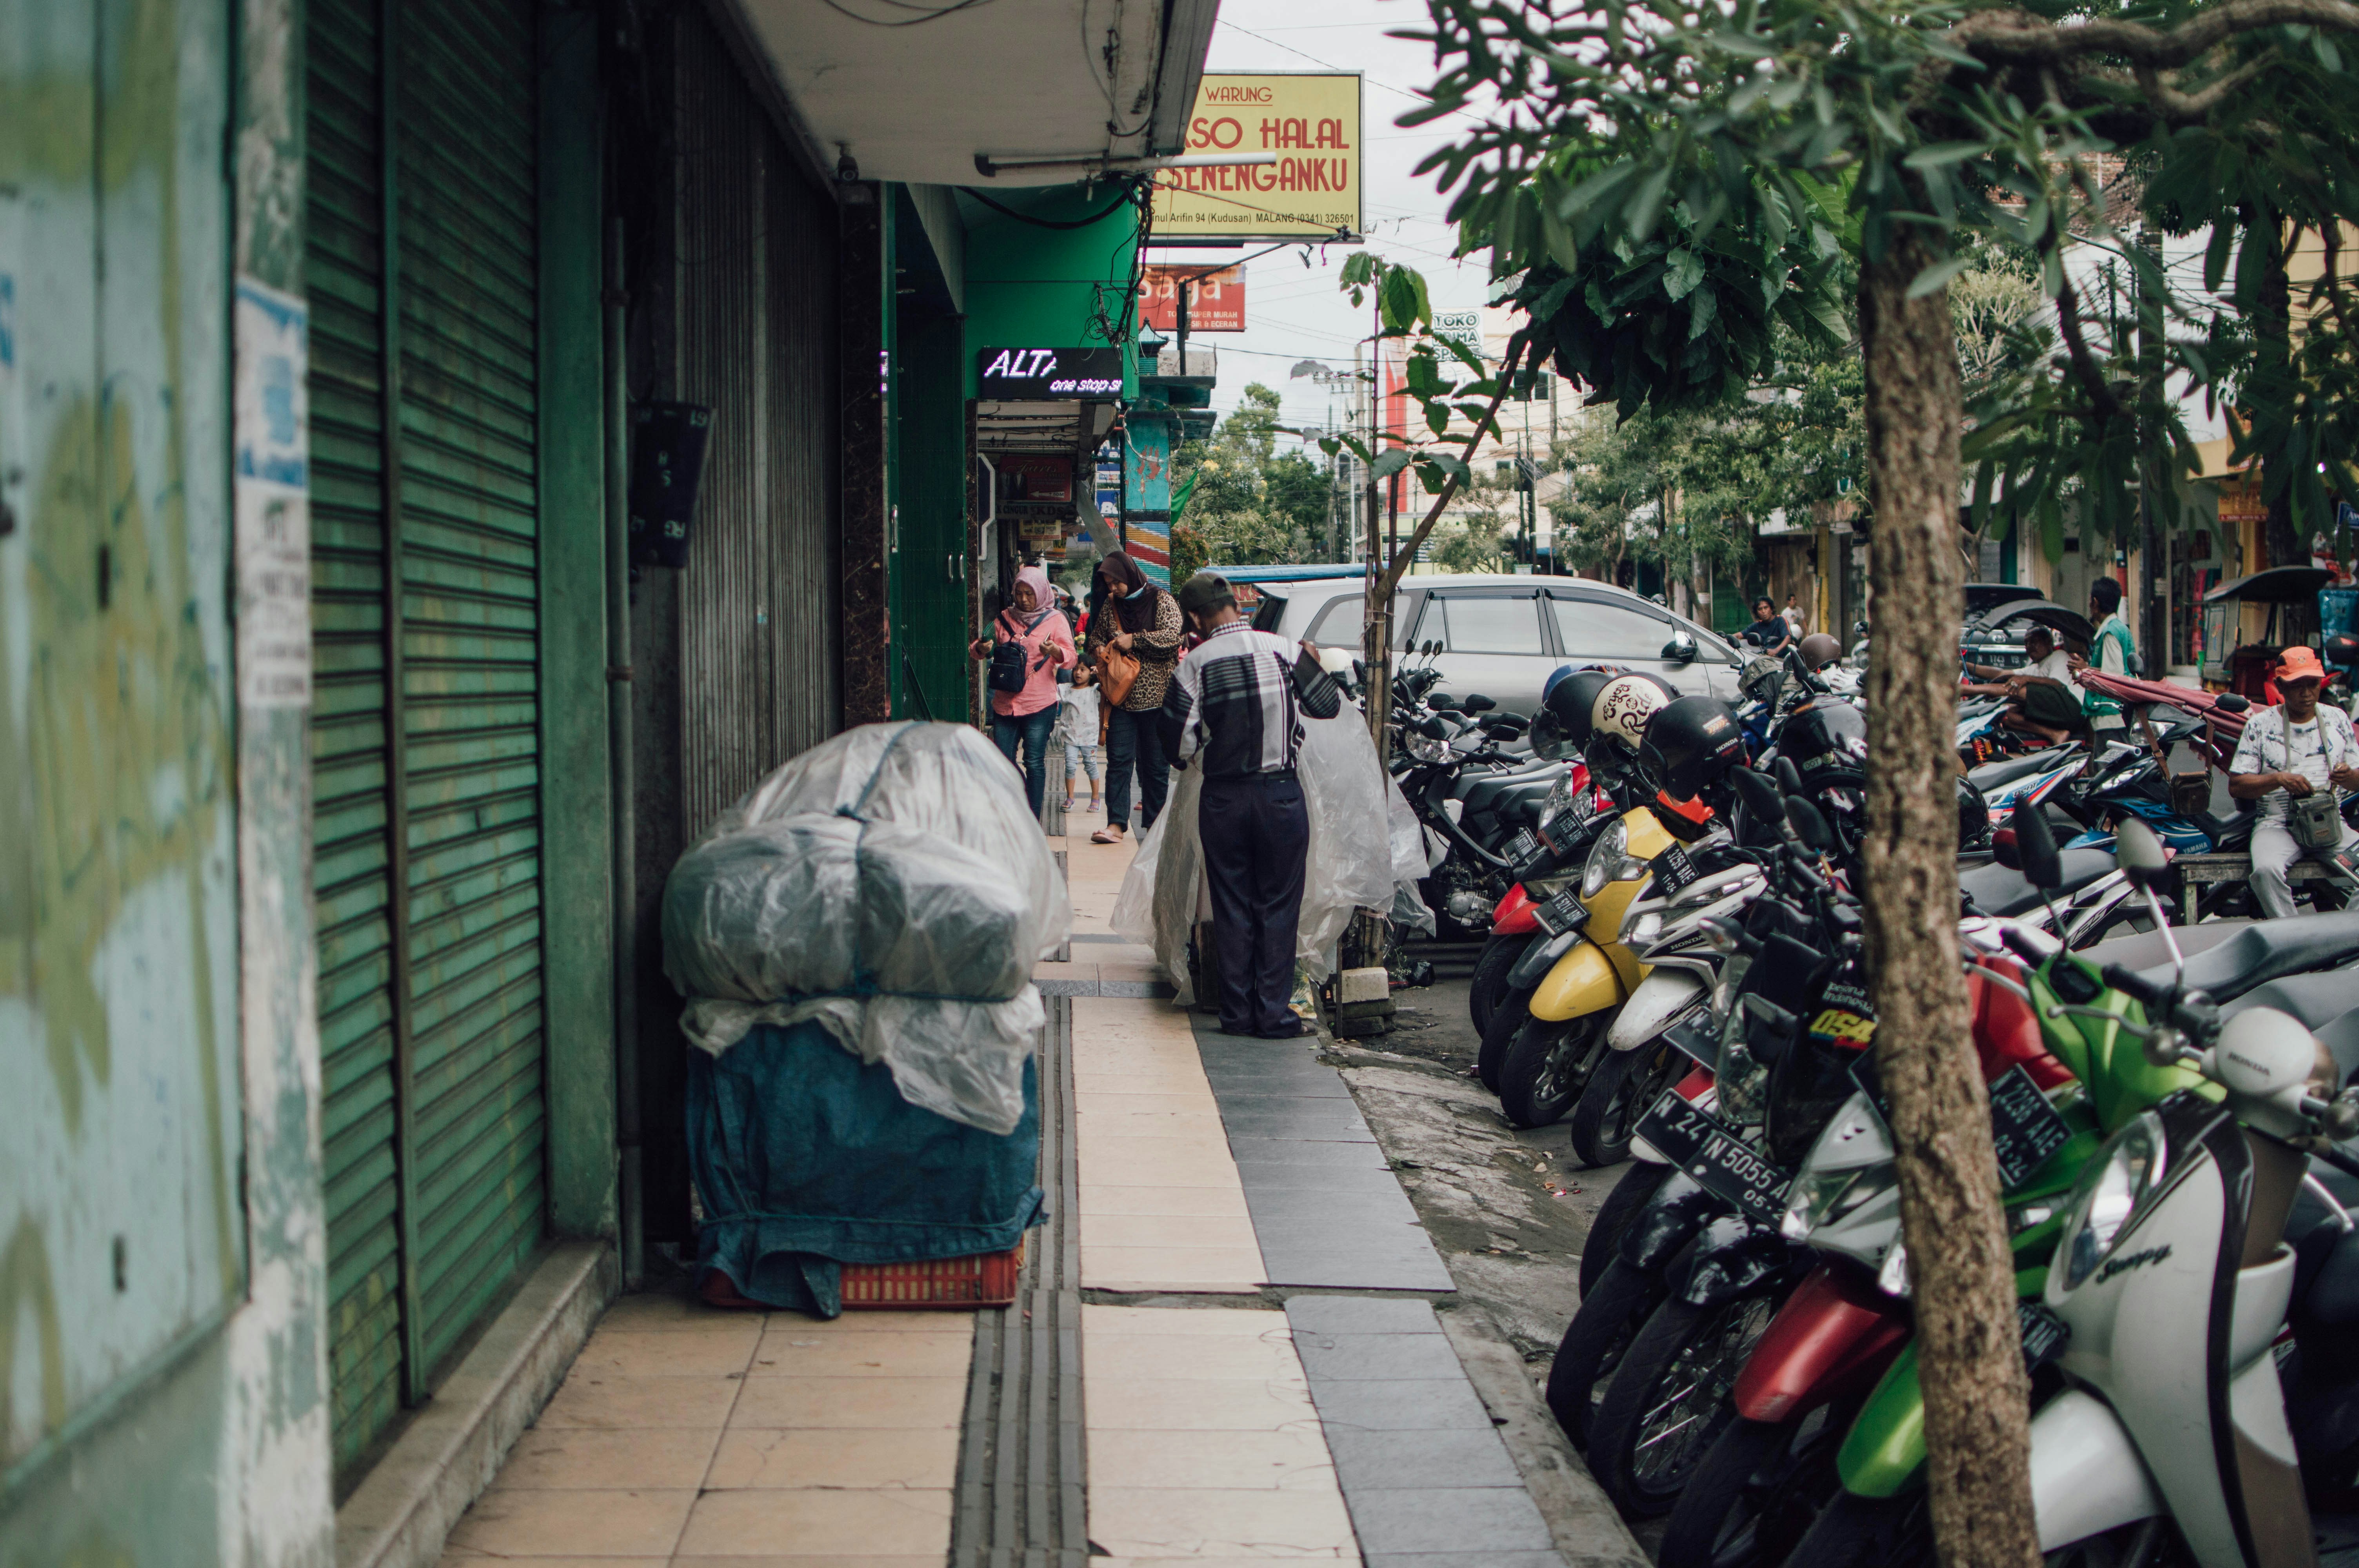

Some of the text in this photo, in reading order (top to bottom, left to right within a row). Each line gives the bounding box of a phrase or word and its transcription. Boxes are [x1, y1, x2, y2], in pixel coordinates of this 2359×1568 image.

[1205, 86, 1273, 102] WARUNG
[1259, 118, 1350, 149] HALAL
[1170, 213, 1193, 222] Arifin
[1196, 213, 1205, 222] 94
[1208, 213, 1251, 224] (Kudusan)
[1256, 213, 1295, 223] MALANG
[1297, 213, 1323, 225] (0341)
[1325, 213, 1354, 223] 326501
[1433, 313, 1478, 328] TOKO
[1050, 379, 1077, 392] one
[1077, 378, 1109, 394] stop
[1715, 737, 1738, 753] HONDA
[1805, 759, 1819, 768] DOT
[2183, 842, 2208, 854] YAMAHA
[1667, 848, 1686, 870] 3259
[1676, 864, 1696, 884] BAE
[1670, 935, 1705, 950] HONDA
[1687, 1010, 1708, 1029] N
[2228, 1051, 2272, 1076] HONDA
[1655, 1096, 1677, 1117] N
[1704, 1138, 1724, 1160] N
[1721, 1148, 1777, 1189] 5055
